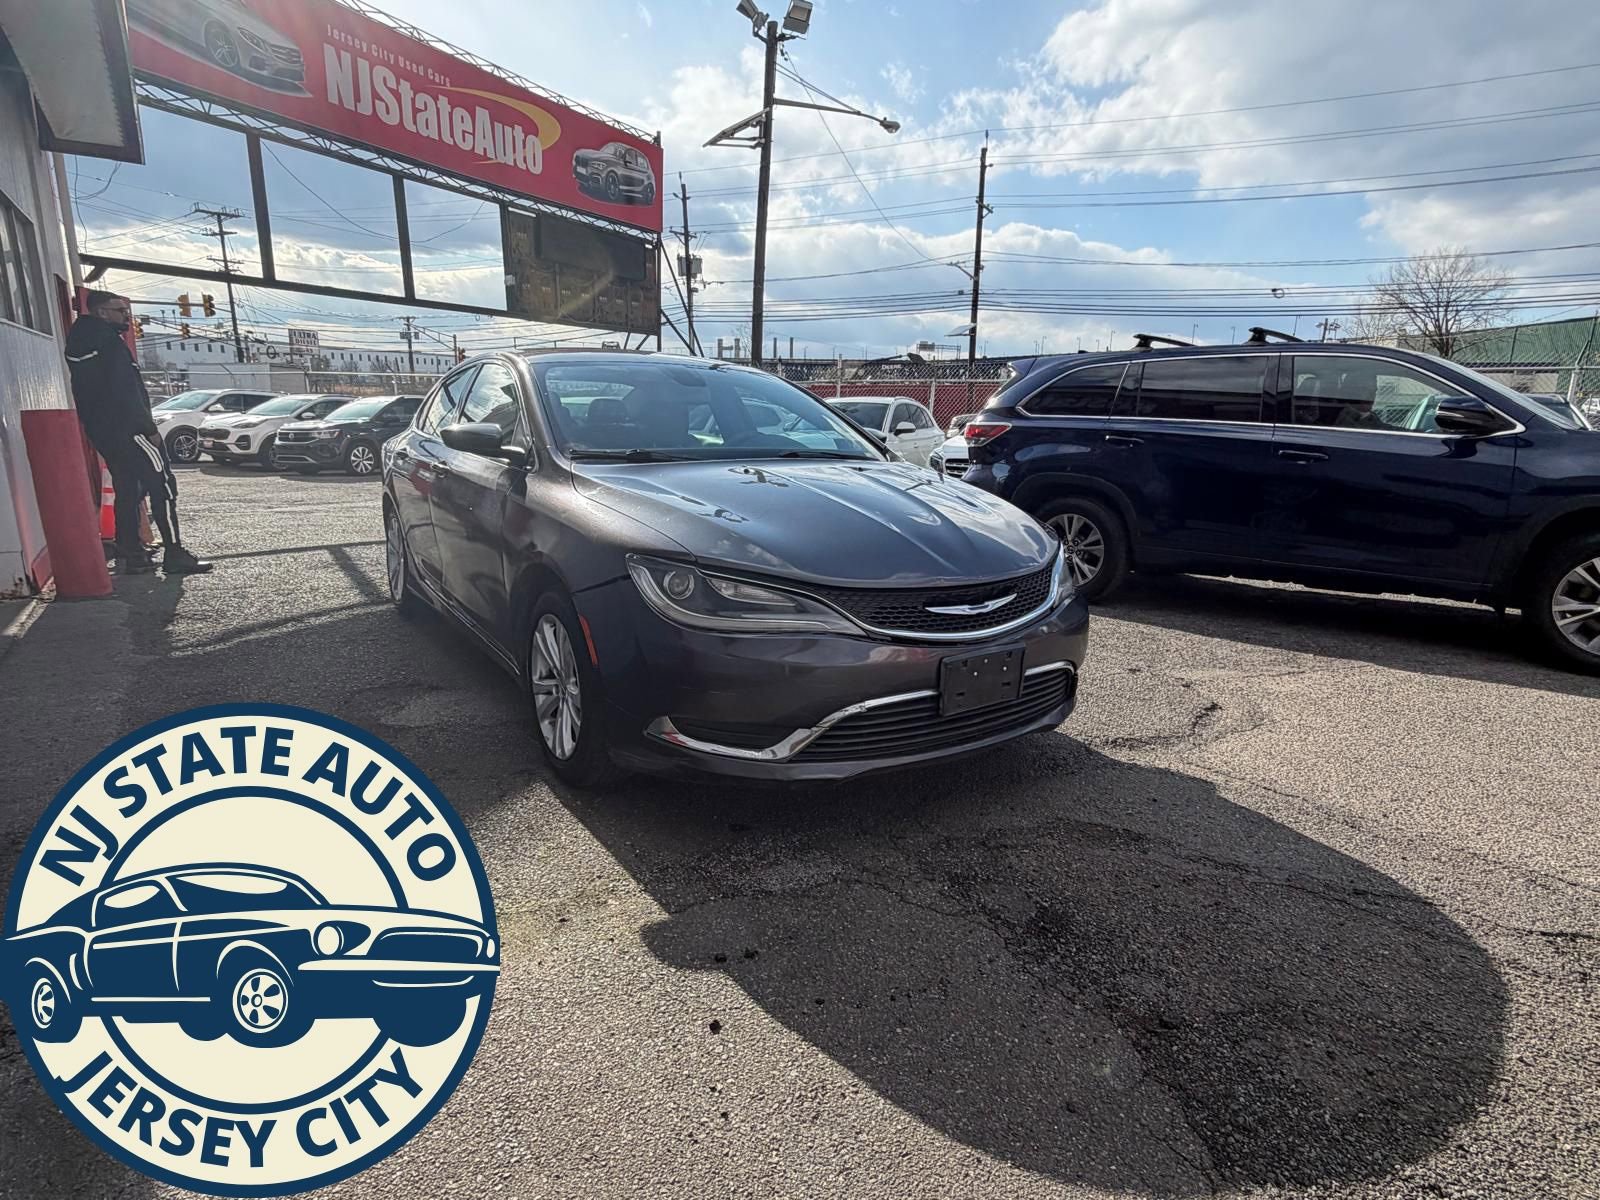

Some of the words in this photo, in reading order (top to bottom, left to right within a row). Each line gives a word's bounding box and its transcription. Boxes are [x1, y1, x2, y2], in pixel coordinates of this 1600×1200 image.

[327, 24, 368, 50] Jersey
[371, 43, 395, 65] City
[399, 55, 425, 77] Used
[427, 67, 451, 87] Cars
[323, 43, 543, 175] NJStateAuto
